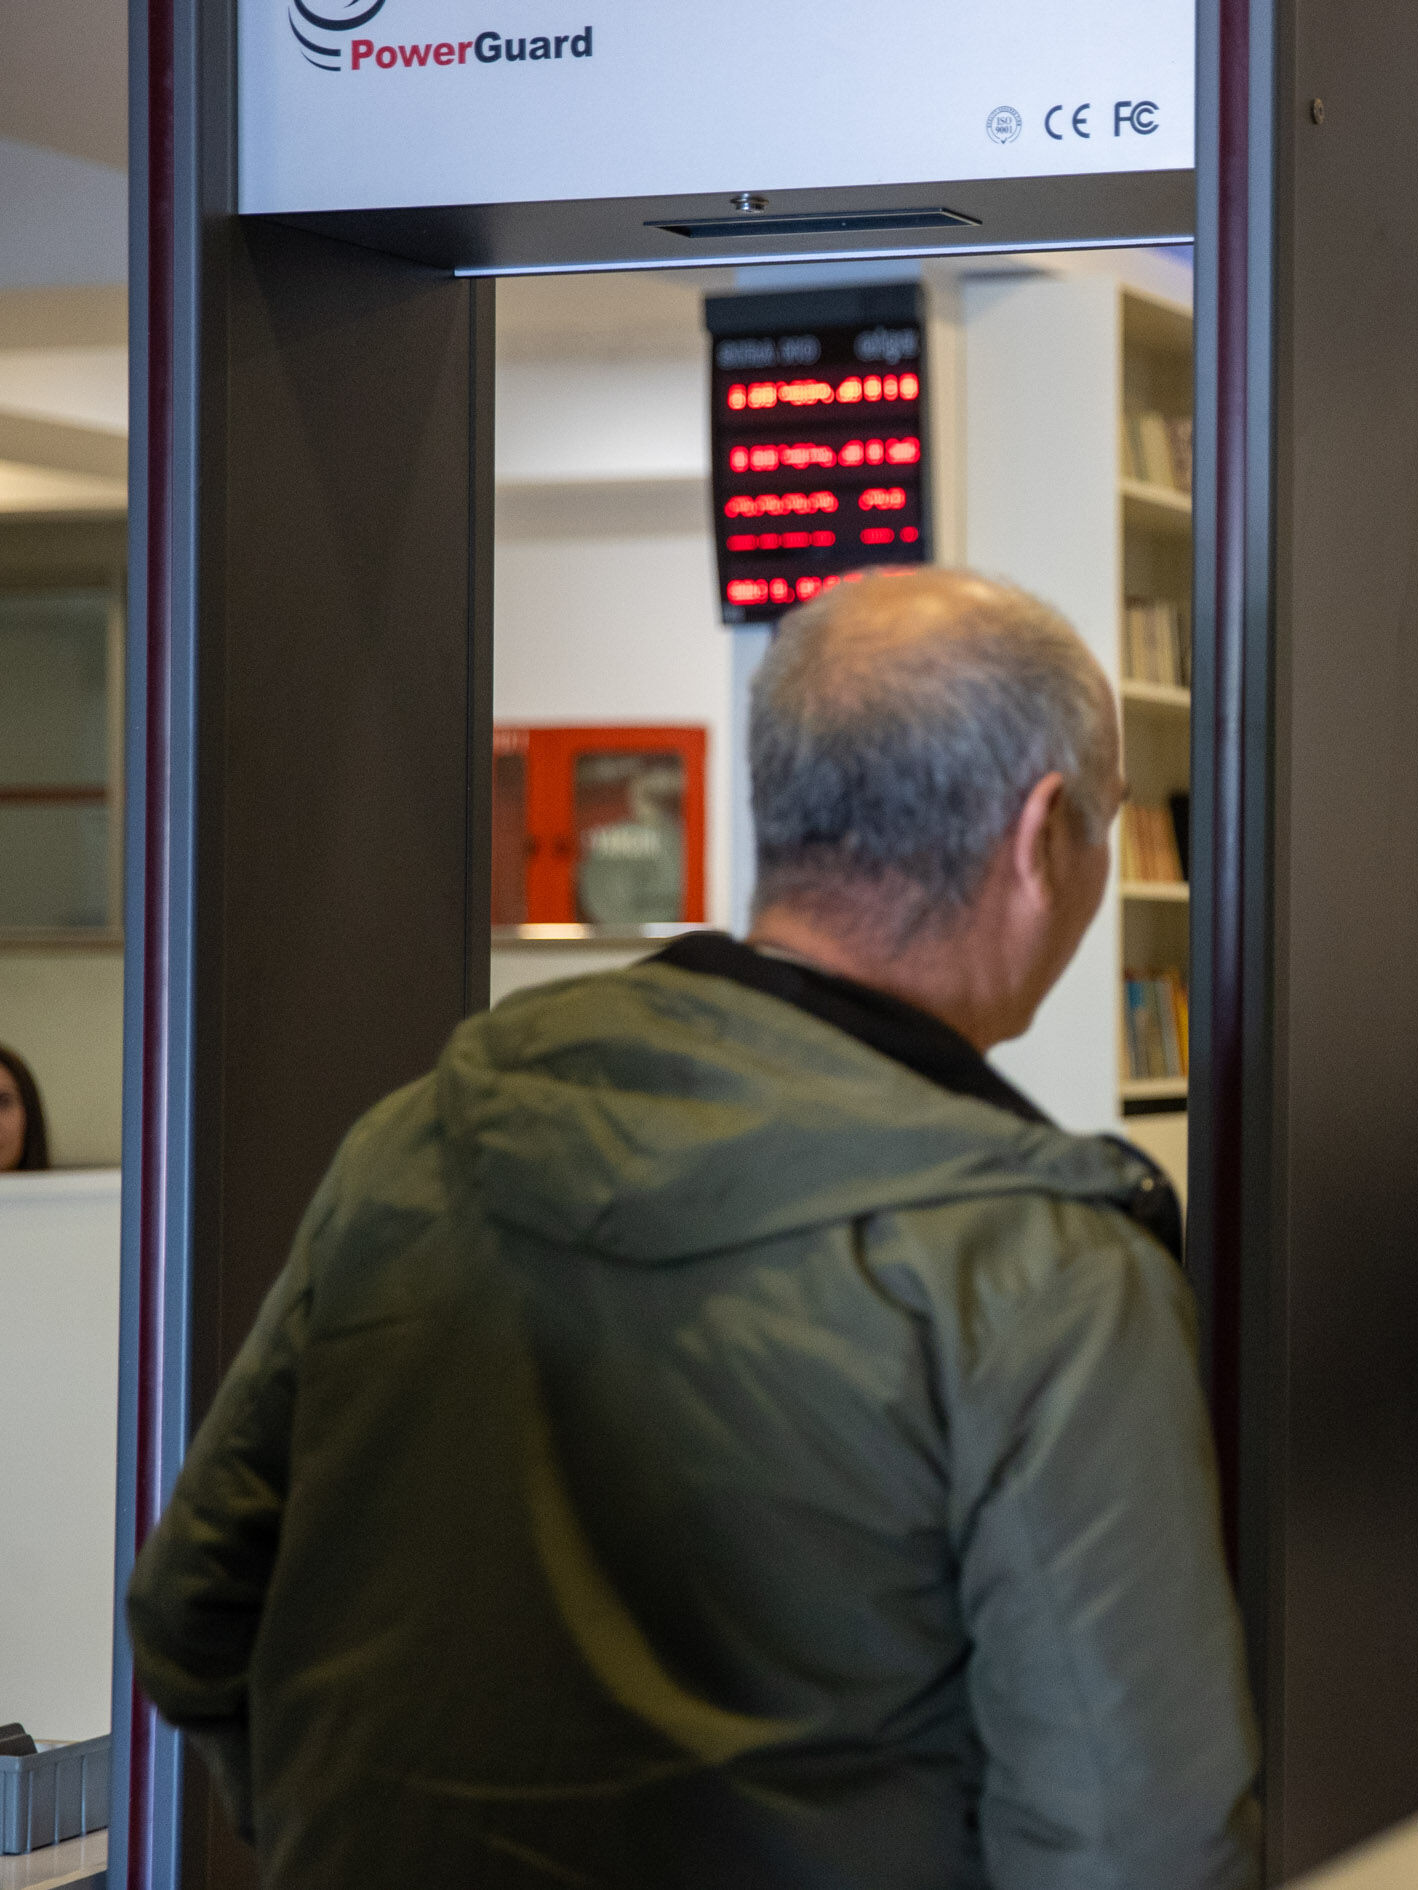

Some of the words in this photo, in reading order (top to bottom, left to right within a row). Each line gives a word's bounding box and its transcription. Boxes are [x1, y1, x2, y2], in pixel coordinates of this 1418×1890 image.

[351, 26, 593, 70] PowerGuard
[995, 125, 1012, 134] 9001
[997, 116, 1012, 125] ISO
[1044, 103, 1090, 140] CE
